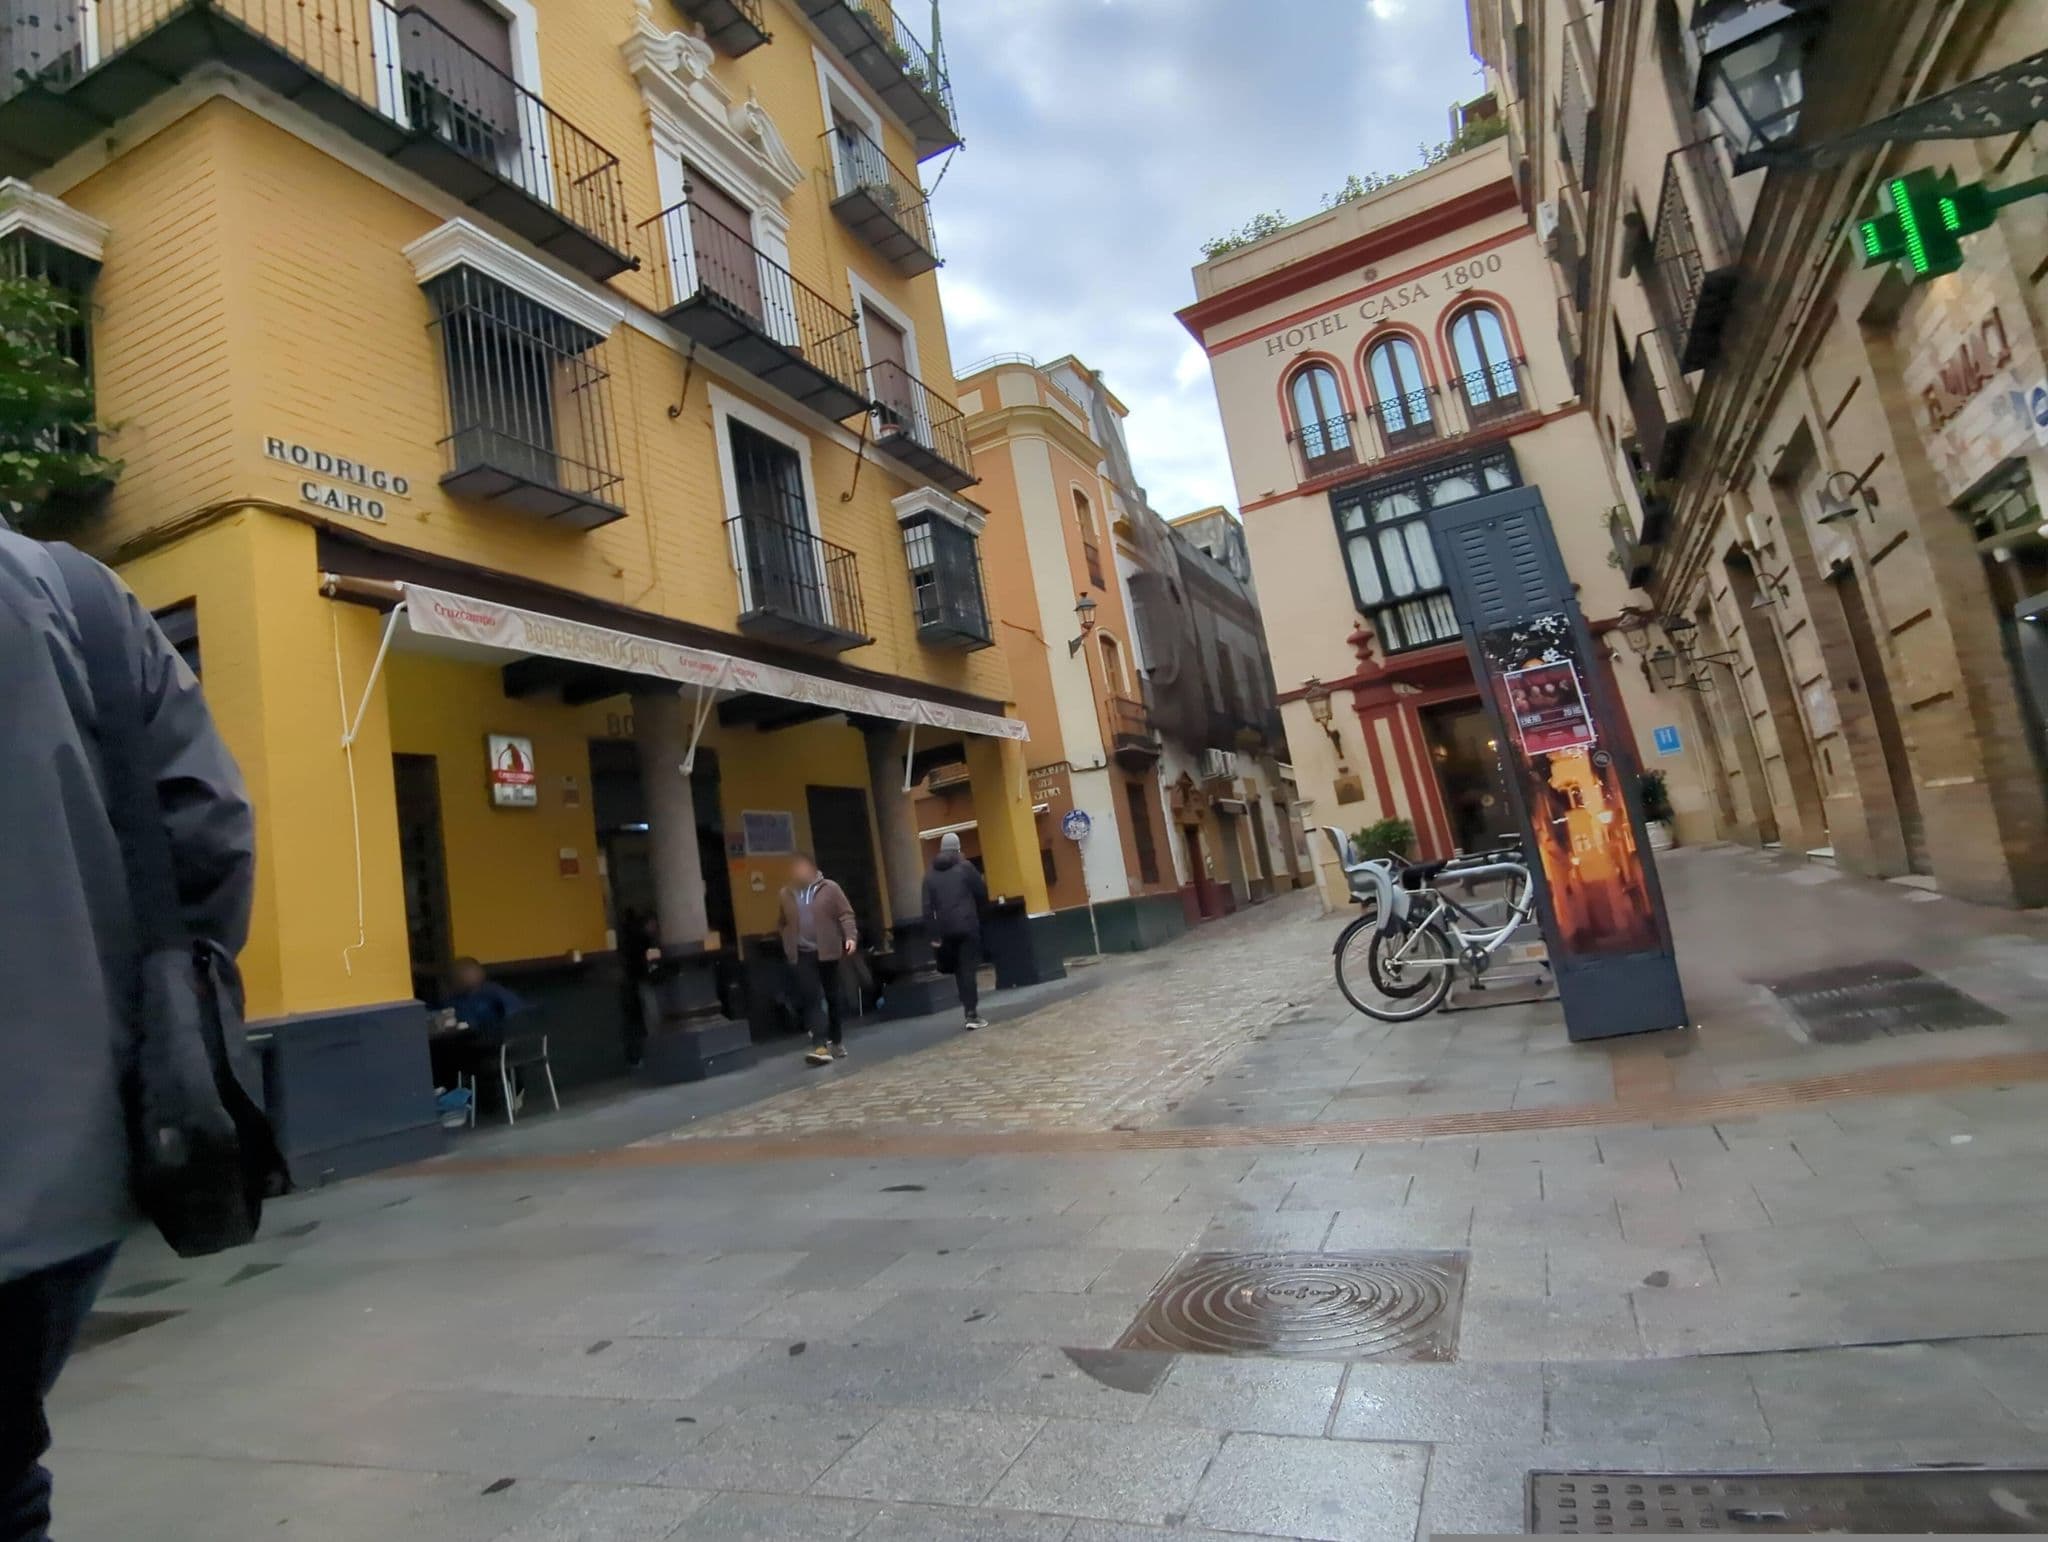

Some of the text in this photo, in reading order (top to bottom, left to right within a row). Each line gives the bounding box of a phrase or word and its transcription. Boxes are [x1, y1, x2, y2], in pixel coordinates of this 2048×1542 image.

[1265, 254, 1502, 357] HOTEL CASA 1800
[266, 436, 409, 495] RODRIGO
[301, 481, 384, 519] CARO
[434, 602, 496, 628] Cruzcampo
